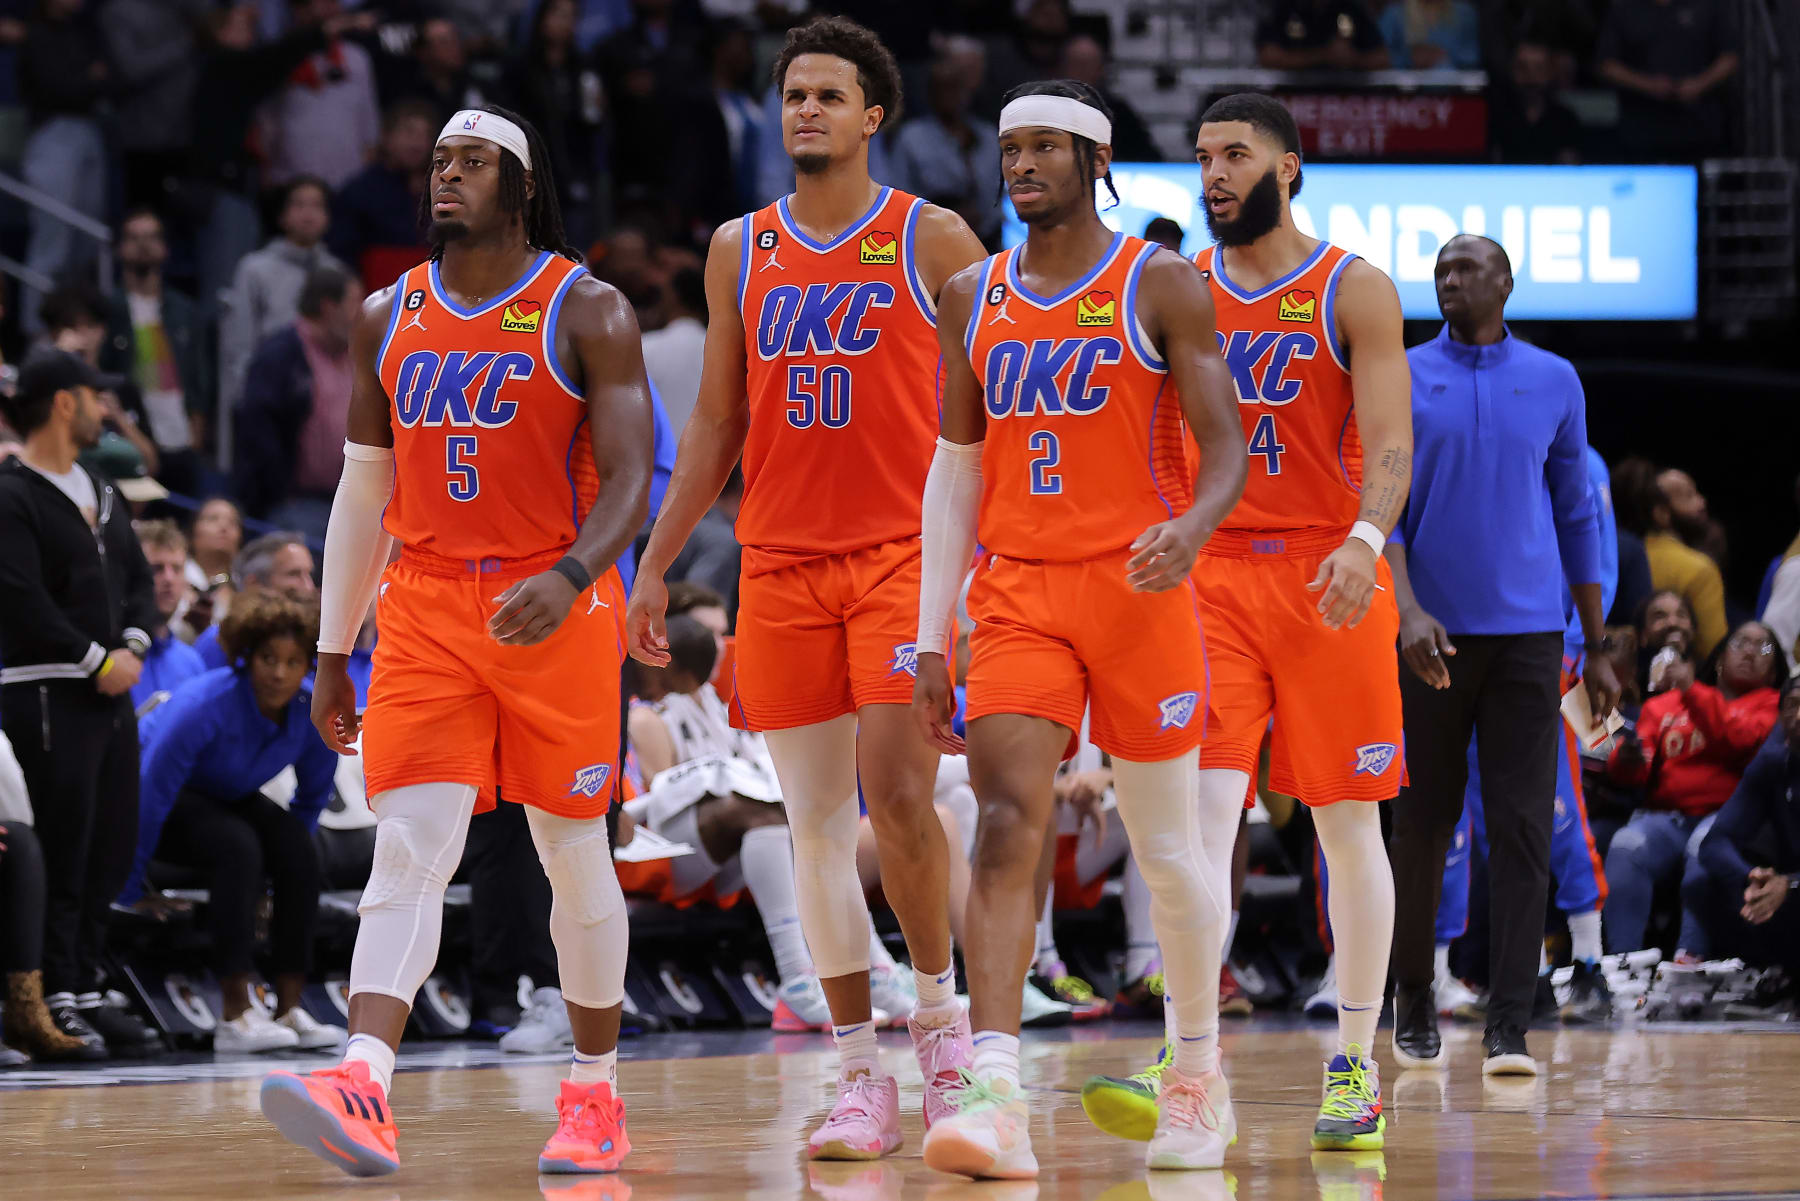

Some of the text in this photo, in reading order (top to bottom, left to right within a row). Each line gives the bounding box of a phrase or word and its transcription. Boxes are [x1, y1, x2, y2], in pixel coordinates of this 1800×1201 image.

[760, 232, 774, 248] 6
[1290, 204, 1641, 283] NDUEL
[408, 291, 422, 309] 6
[757, 281, 896, 362] OKC
[990, 285, 1004, 304] 6
[394, 350, 536, 429] OKC
[786, 364, 852, 430] 50
[984, 336, 1124, 420] OKC
[1215, 330, 1319, 407] KC
[445, 435, 480, 503] 5
[1028, 429, 1063, 496] 2
[1247, 413, 1286, 476] 4
